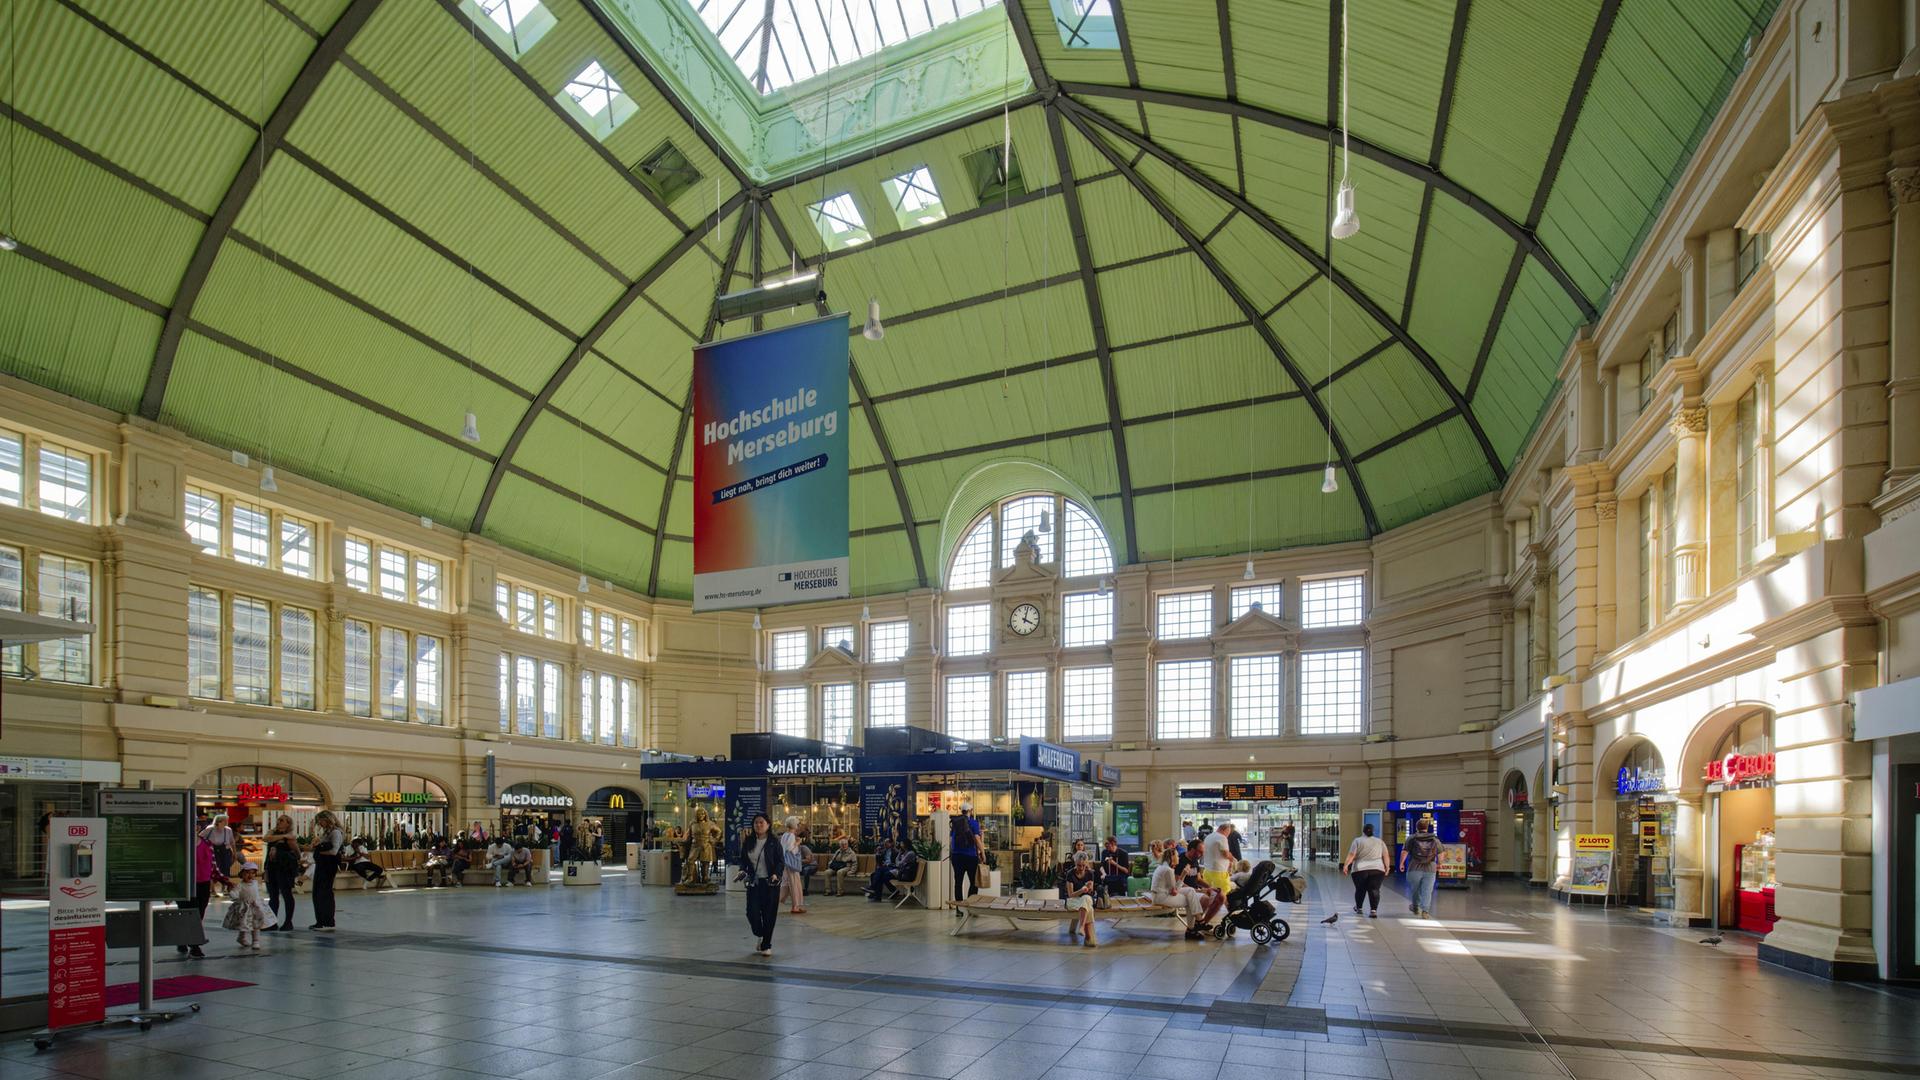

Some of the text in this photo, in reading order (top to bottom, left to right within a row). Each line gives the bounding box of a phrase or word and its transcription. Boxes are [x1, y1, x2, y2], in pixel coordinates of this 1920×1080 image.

[703, 387, 818, 446] Hochschule
[727, 410, 838, 466] Merseburg
[720, 457, 820, 500] Liegt nah, bringt dich weiter!
[794, 567, 838, 581] HOCHSCHULE
[794, 578, 838, 591] MERSEBURG
[704, 587, 762, 601] www.hs-merseburg.de
[778, 757, 853, 774] HAFERKATER
[1043, 747, 1074, 773] HAFERKATER
[1707, 760, 1723, 779] LE
[238, 783, 285, 800] Ditsch
[373, 792, 433, 804] SUBWAY
[500, 793, 573, 807] McDonald's
